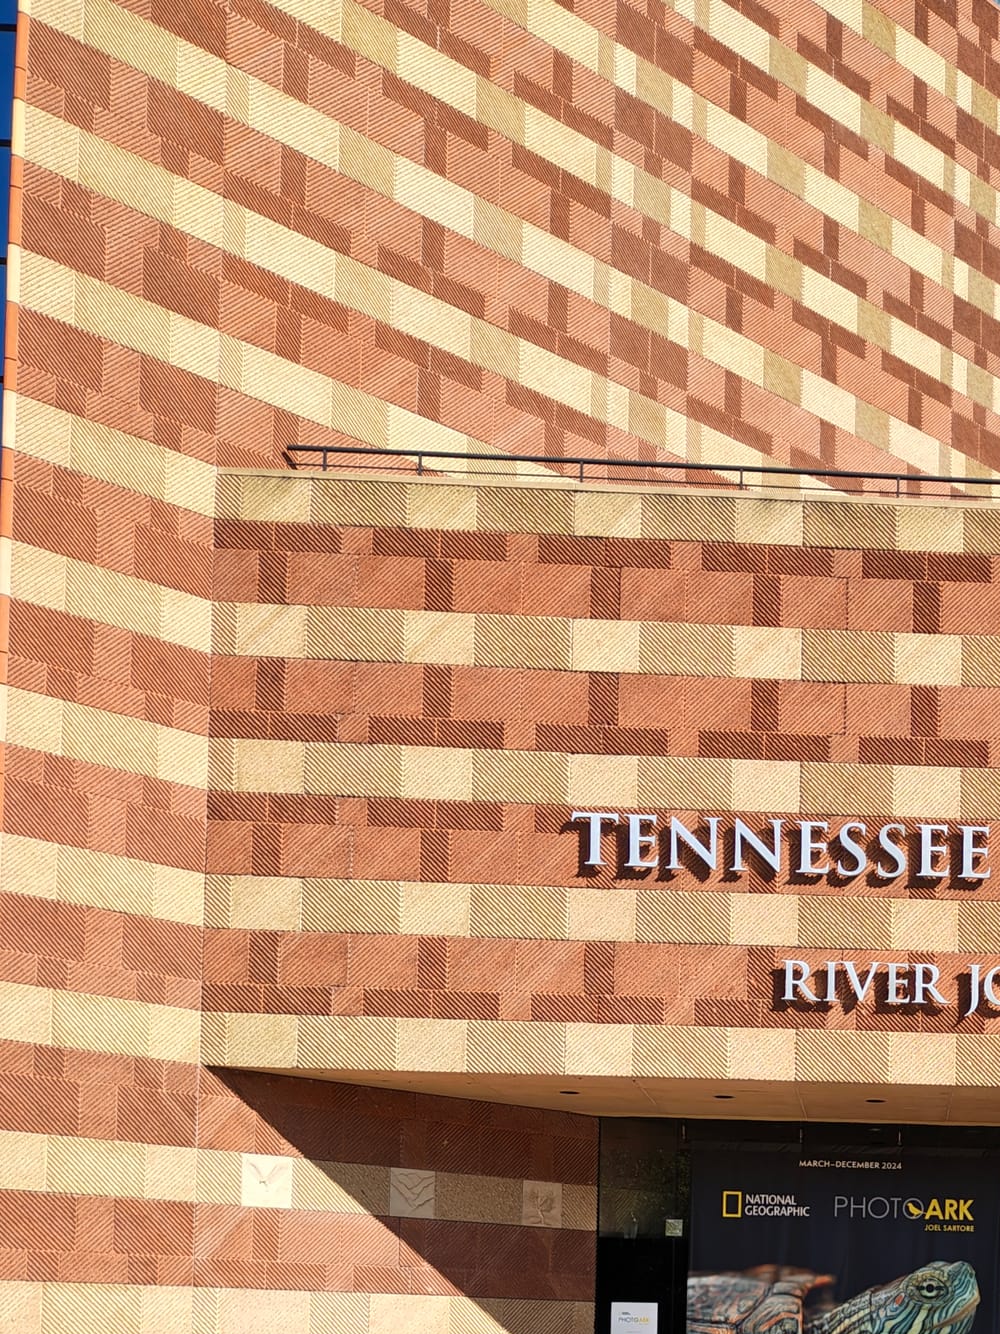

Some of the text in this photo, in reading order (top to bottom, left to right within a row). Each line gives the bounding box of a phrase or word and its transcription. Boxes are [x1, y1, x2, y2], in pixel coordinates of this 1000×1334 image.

[570, 810, 991, 879] TENNESSEE
[781, 959, 949, 1005] RIVER
[881, 1162, 902, 1170] 2024
[745, 1194, 797, 1206] NATIONAL
[744, 1205, 811, 1218] GEOGRAPHIC
[924, 1224, 975, 1233] JOEL SARTORE
